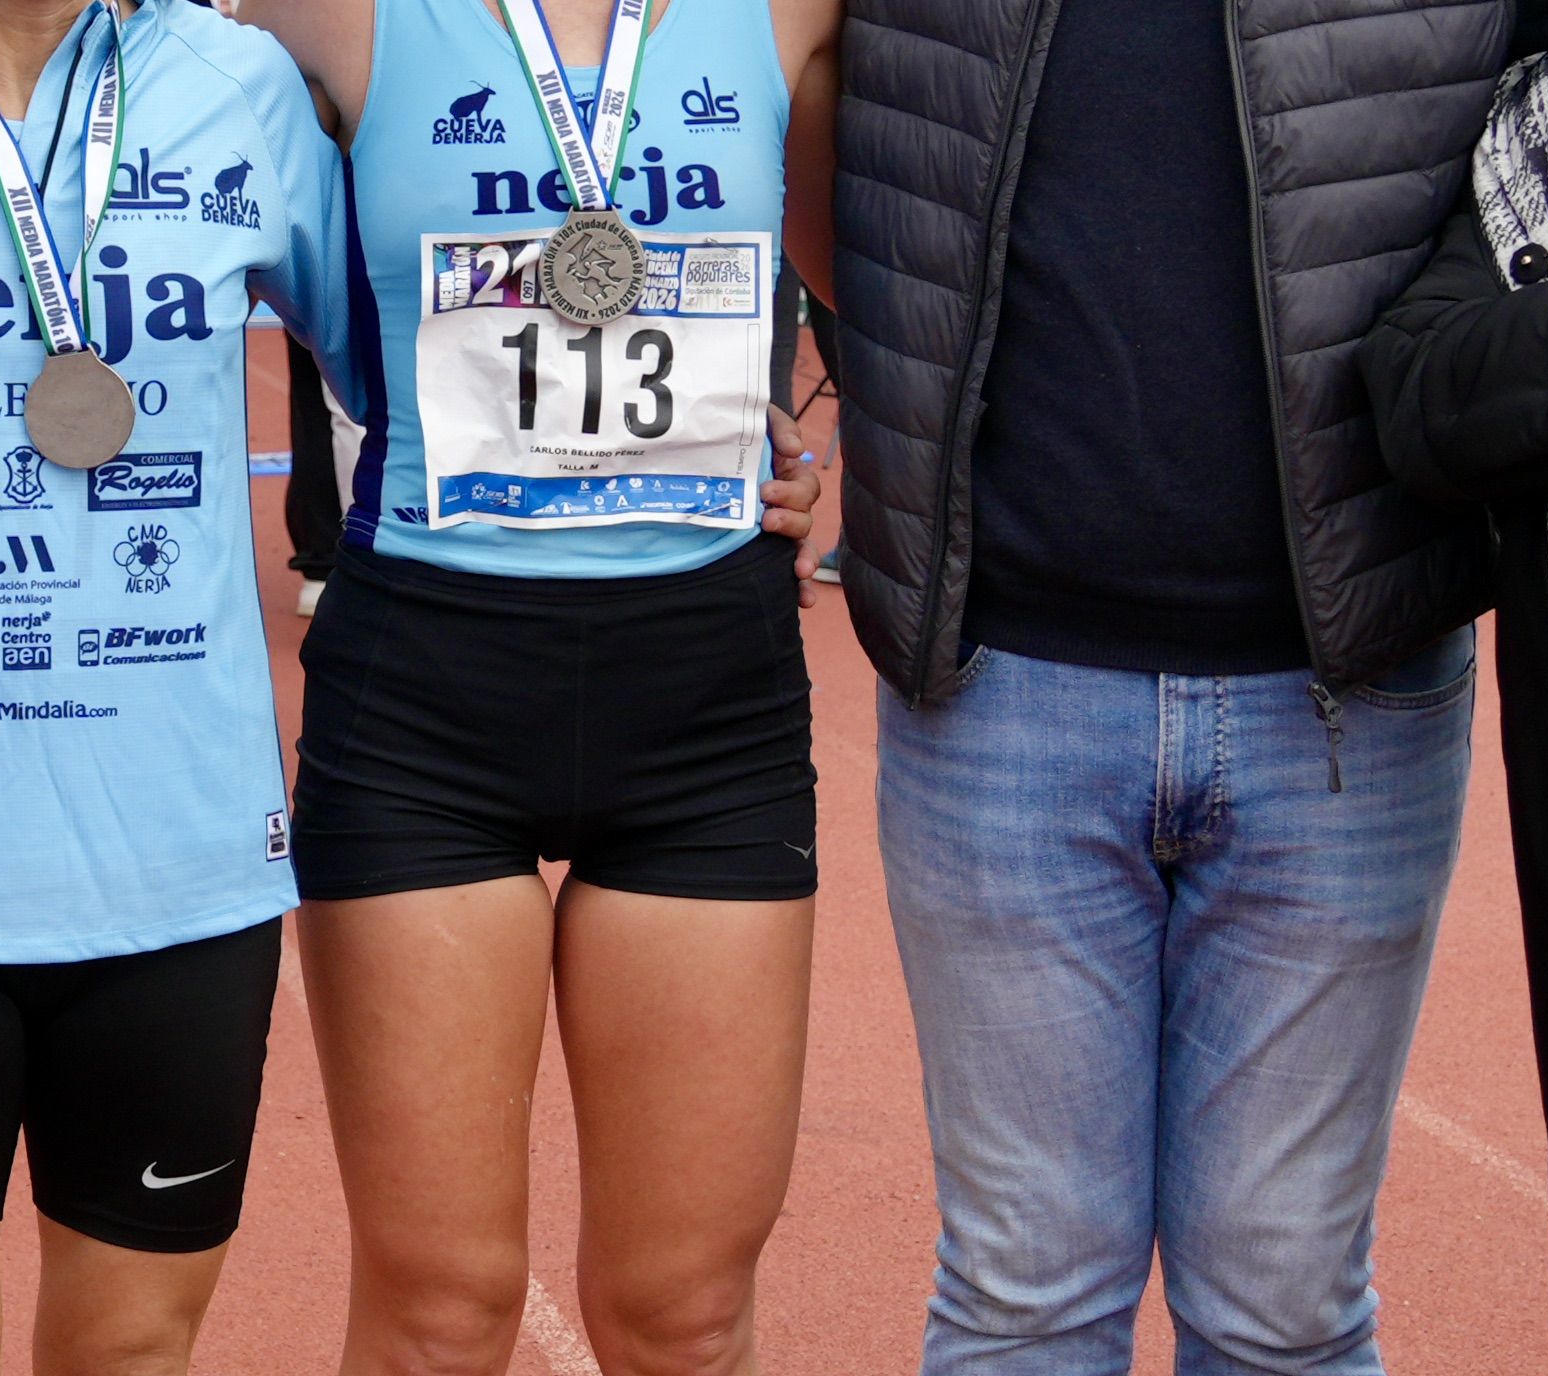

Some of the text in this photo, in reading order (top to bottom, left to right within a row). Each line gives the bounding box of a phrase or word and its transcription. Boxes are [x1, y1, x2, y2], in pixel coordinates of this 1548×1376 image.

[97, 80, 117, 118] MEDIA
[608, 90, 626, 118] 2026
[90, 122, 114, 146] XII
[432, 118, 506, 134] CUEVA
[536, 70, 599, 204] XII MEDIA MARATÓN
[7, 186, 34, 213] XII
[200, 191, 261, 218] CUEVA
[155, 212, 188, 222] shop
[201, 208, 262, 232] DENERJA
[575, 219, 608, 232] Ciudad
[17, 215, 44, 259] MEDIA
[608, 222, 620, 235] de
[618, 229, 640, 261] Lucena
[471, 243, 544, 306] 21
[646, 260, 680, 275] UCENA
[688, 260, 740, 273] carreras
[685, 270, 751, 286] populares
[31, 259, 68, 328] MARATÓN
[522, 280, 534, 299] 097
[618, 276, 643, 307] MARZO
[637, 288, 677, 311] 2026
[501, 322, 677, 440] 113
[140, 454, 195, 465] COMERCIAL
[530, 445, 568, 455] CARLOS
[571, 448, 613, 457] BELLIDO
[557, 463, 585, 471] TALLA
[96, 464, 197, 497] Rogelio
[30, 578, 81, 591] Provincial
[124, 574, 171, 595] NERJA
[14, 593, 53, 606] Málaga
[1, 613, 43, 630] nerja
[0, 631, 52, 645] Centro
[104, 623, 208, 649] BFwork
[4, 647, 50, 666] aen
[103, 650, 207, 666] Comunicaciones
